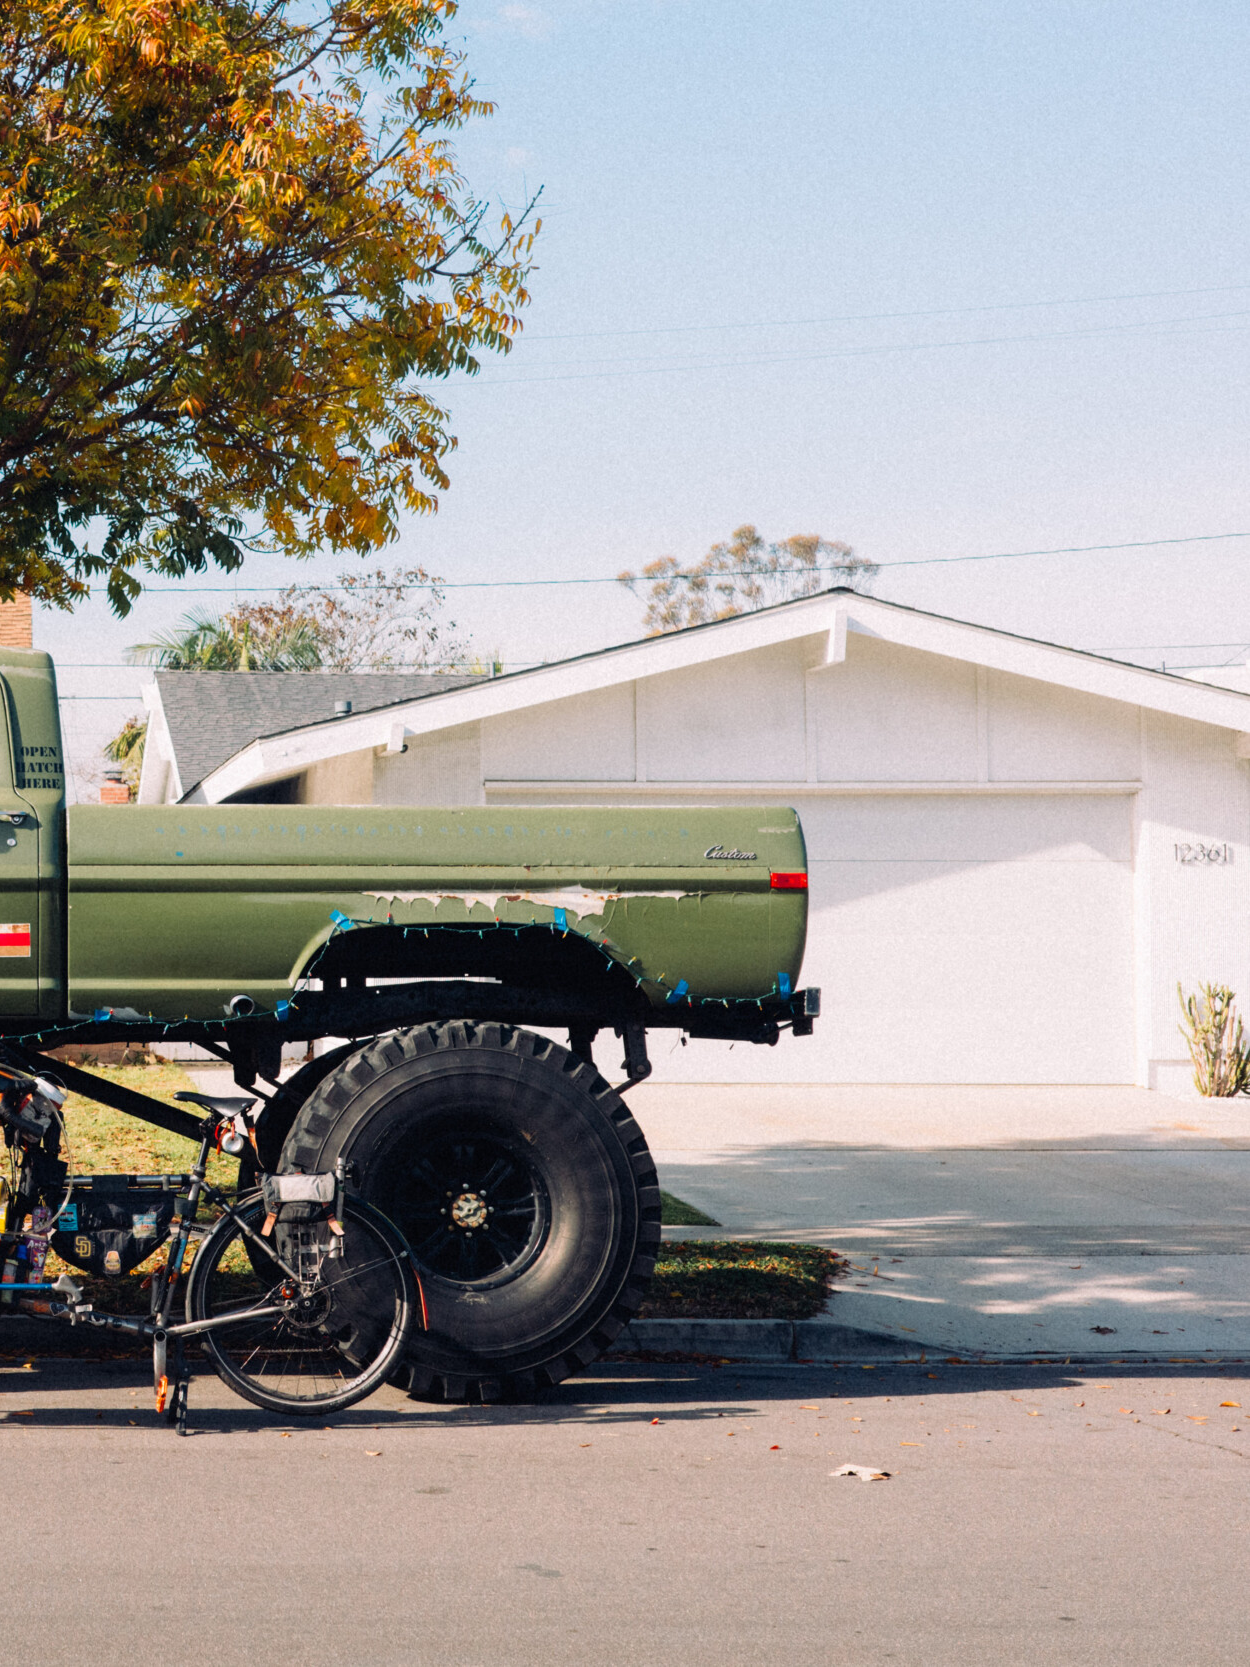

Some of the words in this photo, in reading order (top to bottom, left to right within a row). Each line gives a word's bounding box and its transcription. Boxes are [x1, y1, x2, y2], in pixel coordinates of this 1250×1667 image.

[20, 746, 57, 757] OPEN
[16, 762, 63, 773] HATCH
[22, 778, 60, 790] HERE
[704, 844, 757, 860] Custom
[1174, 843, 1227, 862] 12361
[75, 1236, 92, 1258] SD
